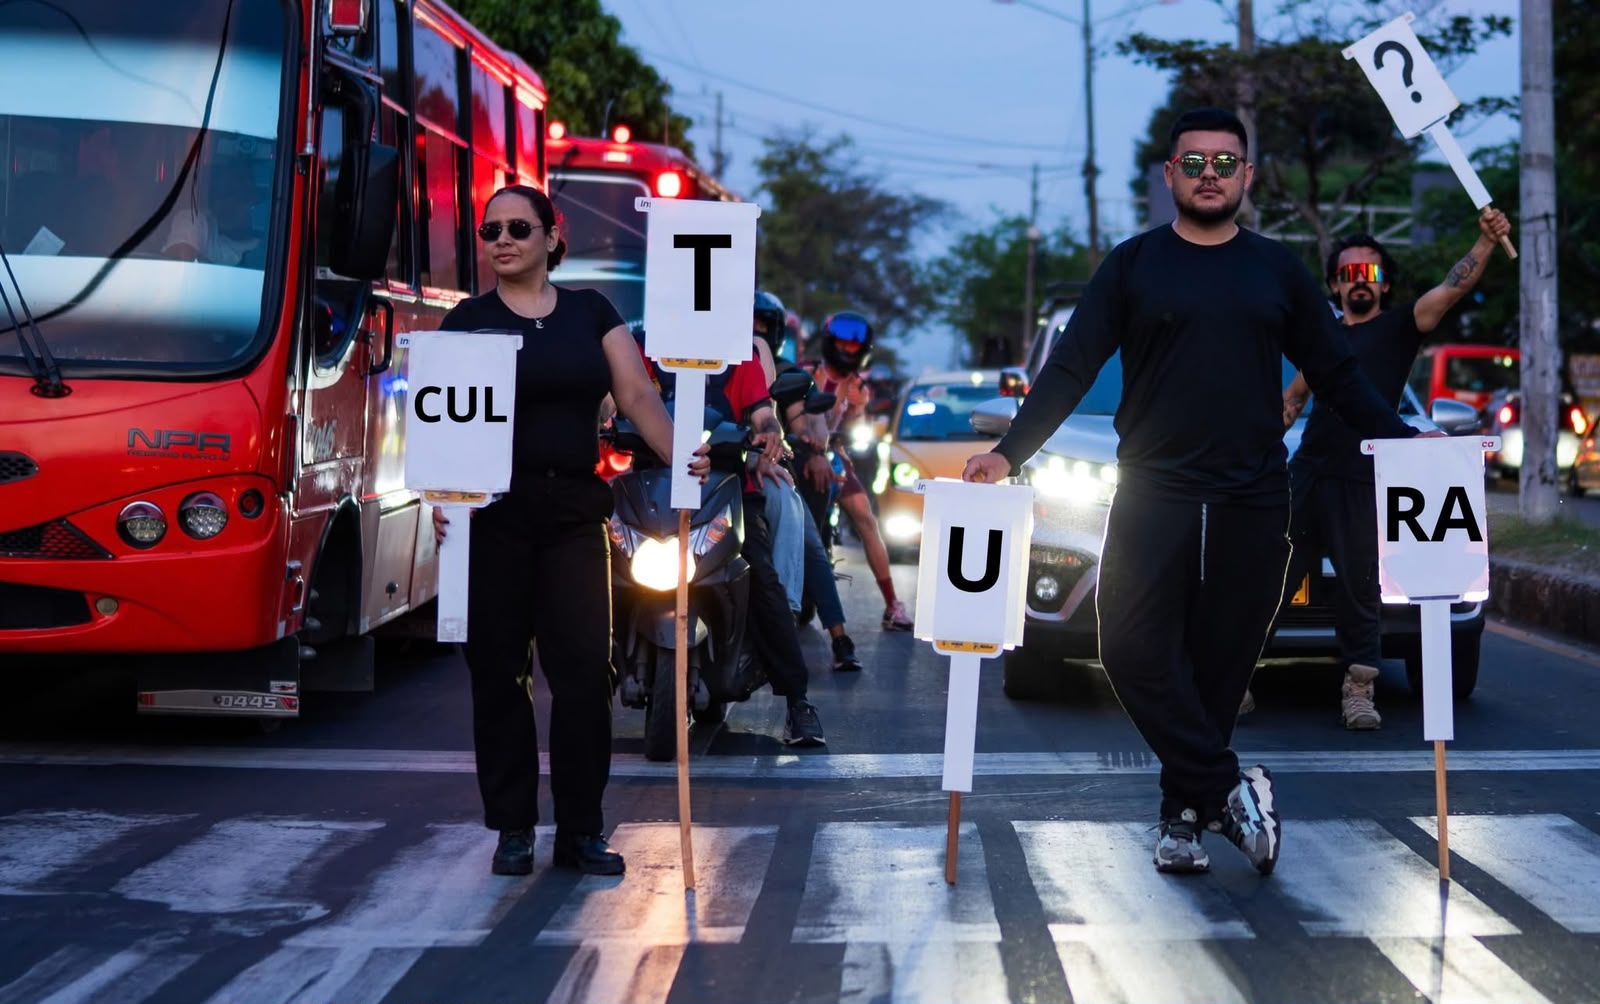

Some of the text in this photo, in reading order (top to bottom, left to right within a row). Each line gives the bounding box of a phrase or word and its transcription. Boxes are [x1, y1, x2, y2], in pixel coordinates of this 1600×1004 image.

[1373, 40, 1423, 104] ?
[674, 235, 732, 311] T
[414, 385, 508, 423] CUL
[128, 428, 231, 453] NPR
[1386, 486, 1484, 542] RA
[947, 526, 1003, 593] U
[221, 695, 277, 709] 0445
